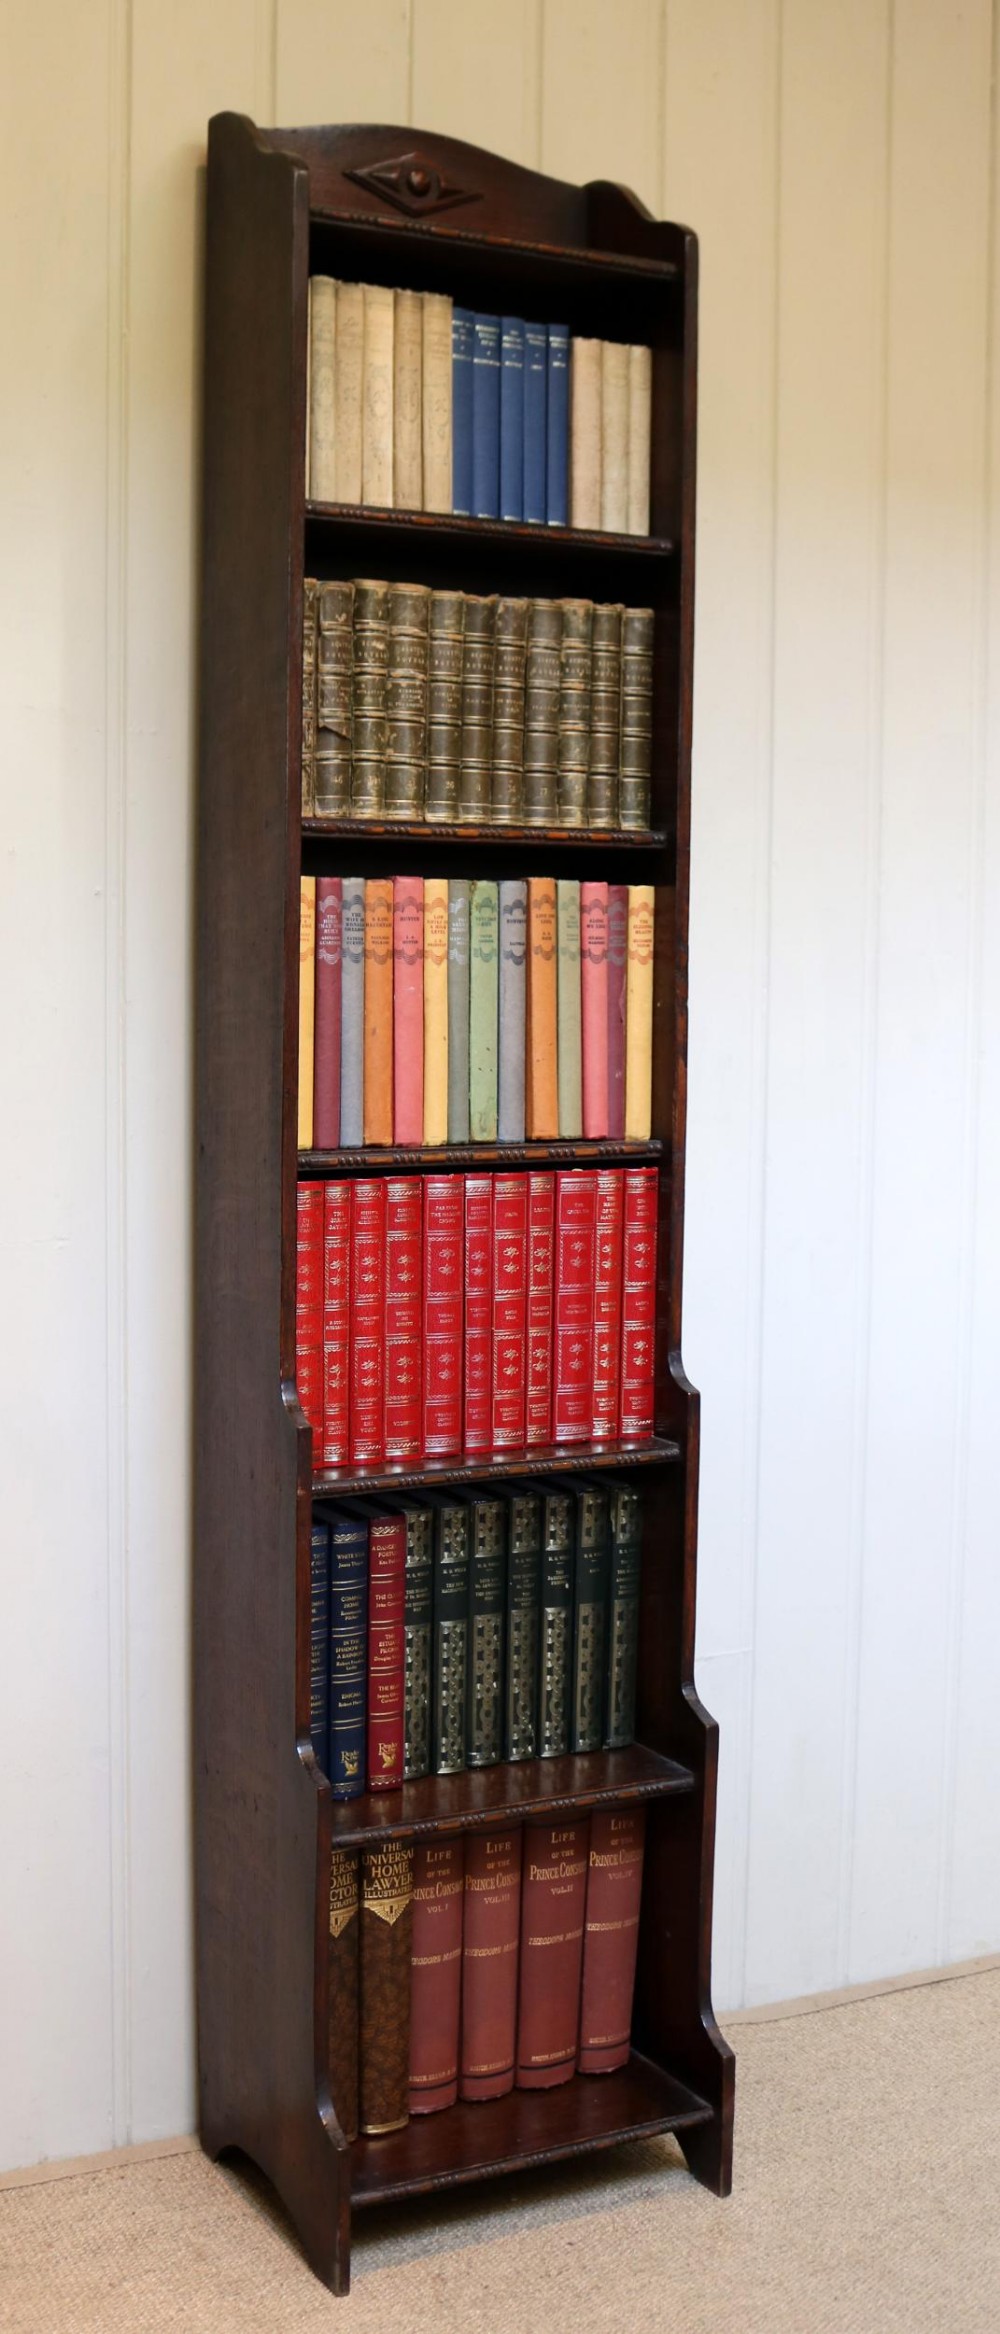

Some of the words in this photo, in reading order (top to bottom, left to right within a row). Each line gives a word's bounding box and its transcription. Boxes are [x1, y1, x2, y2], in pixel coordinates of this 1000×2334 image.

[551, 1832, 575, 1844] LIFE
[382, 1842, 402, 1853] THE
[486, 1842, 511, 1854] LIFE
[332, 1853, 345, 1864] HE
[426, 1850, 452, 1862] LIFE
[590, 1851, 618, 1866] PRINCE
[372, 1861, 409, 1878] HOME
[530, 1865, 560, 1881] PRINCE
[364, 1872, 413, 1891] LAWYER
[465, 1875, 496, 1891] PRINCE
[330, 1884, 358, 1901] CTOR
[364, 1885, 413, 1898] ILLUSTRATED
[413, 1886, 435, 1901] RINCE
